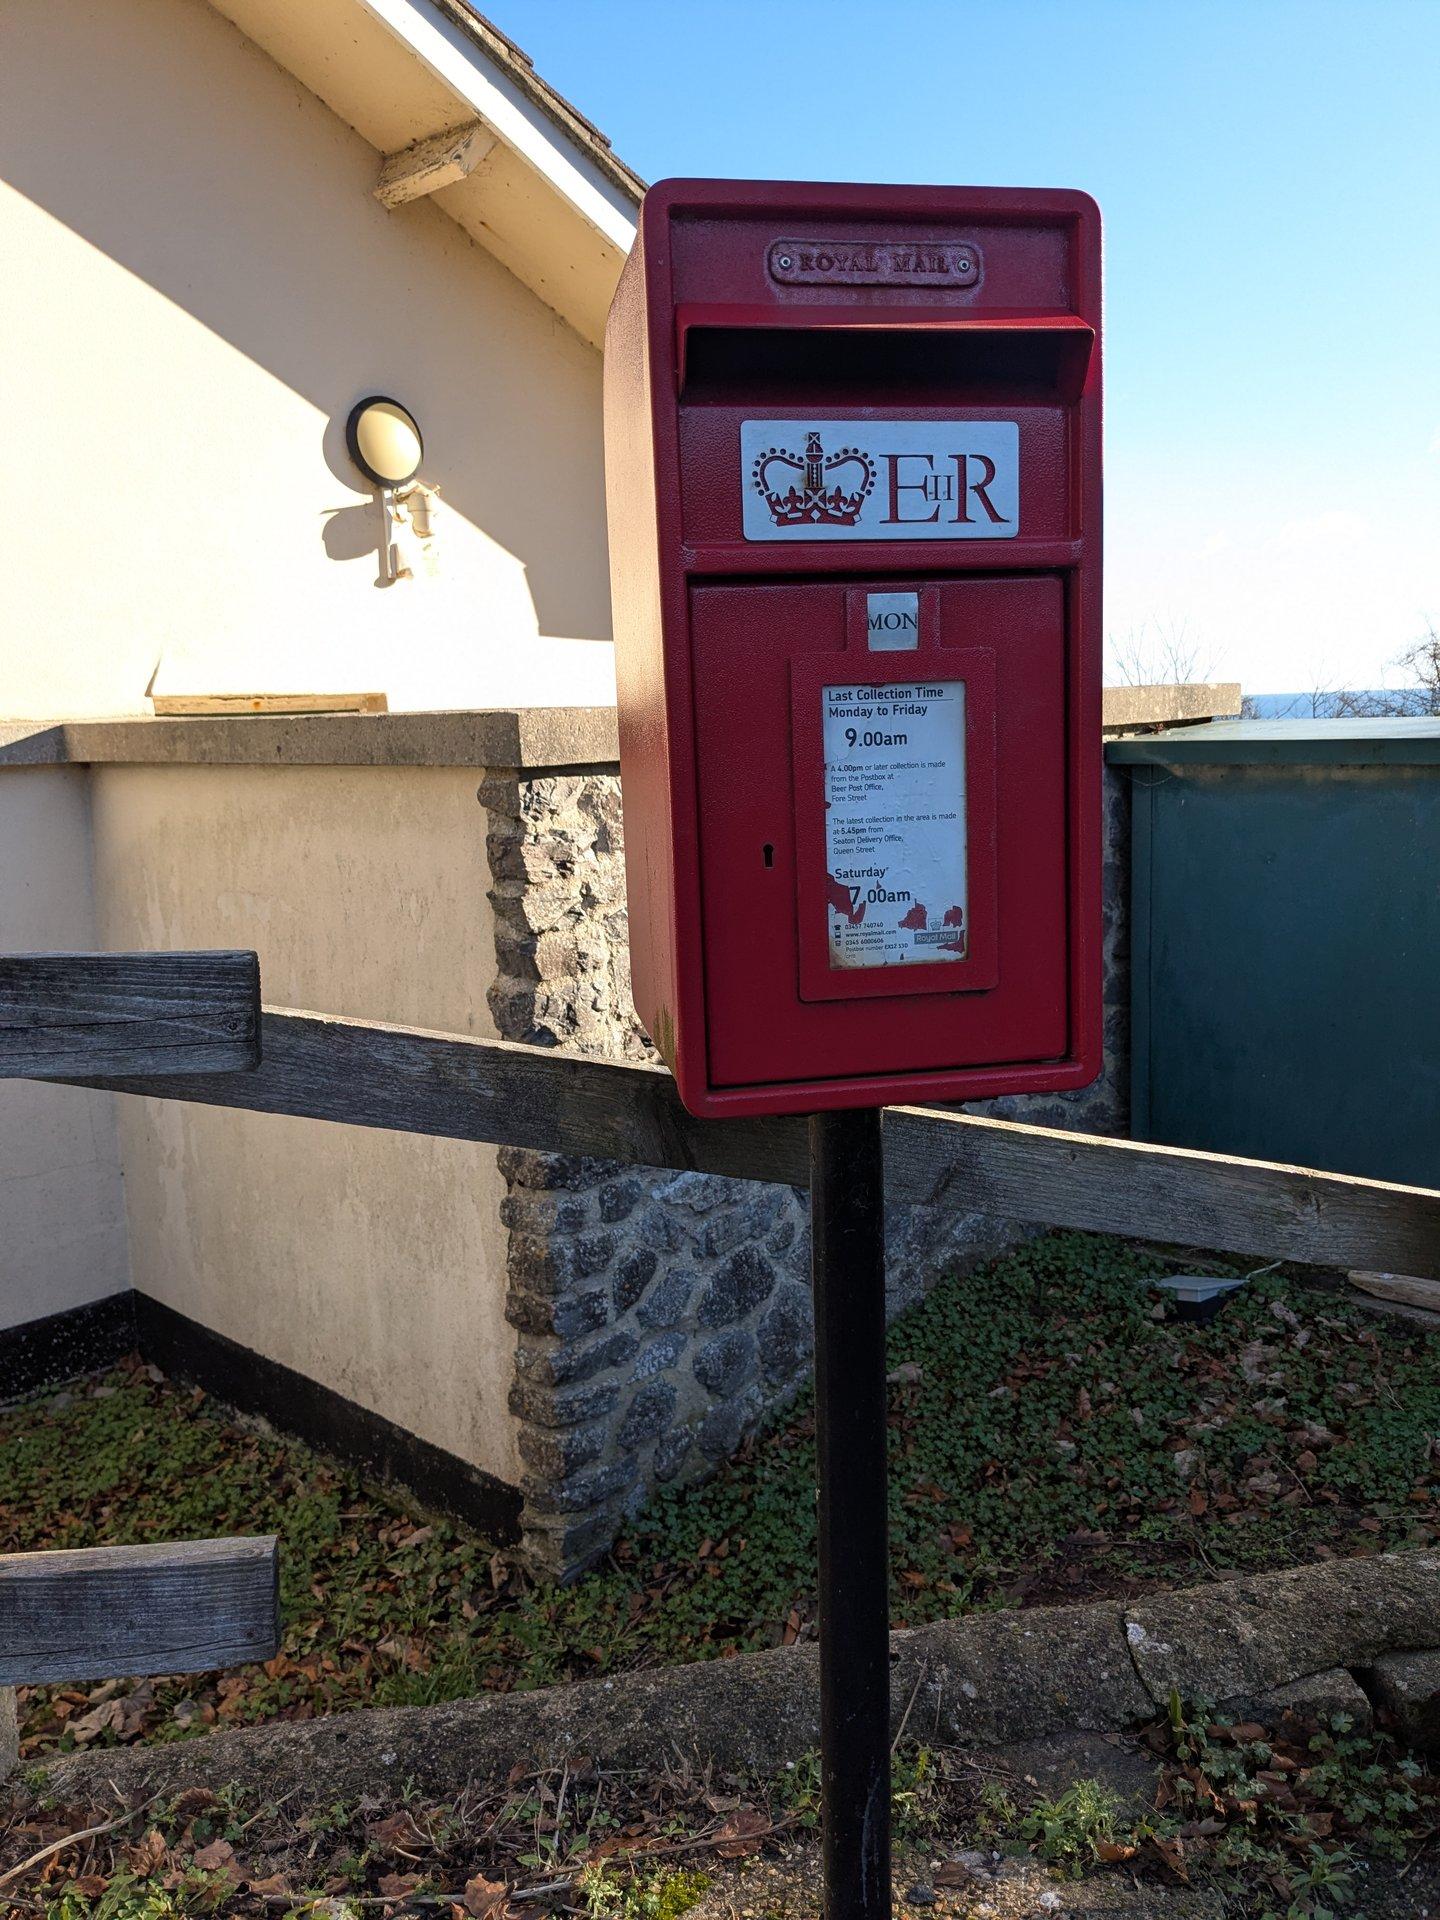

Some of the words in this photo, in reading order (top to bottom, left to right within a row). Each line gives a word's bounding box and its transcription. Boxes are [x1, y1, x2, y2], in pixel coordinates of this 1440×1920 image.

[800, 253, 878, 272] ROYAL
[893, 254, 949, 274] MAIL
[868, 612, 918, 631] MON
[828, 690, 853, 702] Last
[857, 688, 912, 701] Collection
[915, 686, 944, 699] Time
[829, 706, 873, 719] Monday
[877, 705, 889, 717] to
[892, 704, 928, 717] Friday
[844, 728, 908, 748] 9.00am
[837, 764, 864, 773] 4.00pm
[873, 763, 889, 771] later
[889, 762, 920, 770] collection
[920, 761, 927, 769] is
[927, 760, 946, 768] made
[831, 775, 847, 783] from
[848, 774, 859, 782] the
[860, 773, 886, 781] Postbox
[831, 785, 847, 793] Beer
[848, 784, 863, 792] Post
[864, 783, 884, 792] Office,
[831, 795, 846, 803] Fore
[847, 794, 868, 802] Street
[832, 817, 845, 825] The
[846, 817, 864, 825] latest
[865, 815, 895, 824] collection
[938, 812, 957, 820] made
[840, 826, 867, 836] 5.45pm
[833, 837, 856, 845] Seaton
[856, 835, 883, 844] Delivery
[884, 834, 904, 843] Office,
[833, 847, 854, 855] Queen
[855, 846, 876, 854] Street
[849, 886, 911, 905] 7.00am
[916, 934, 938, 944] Royal
[939, 932, 957, 942] Mail
